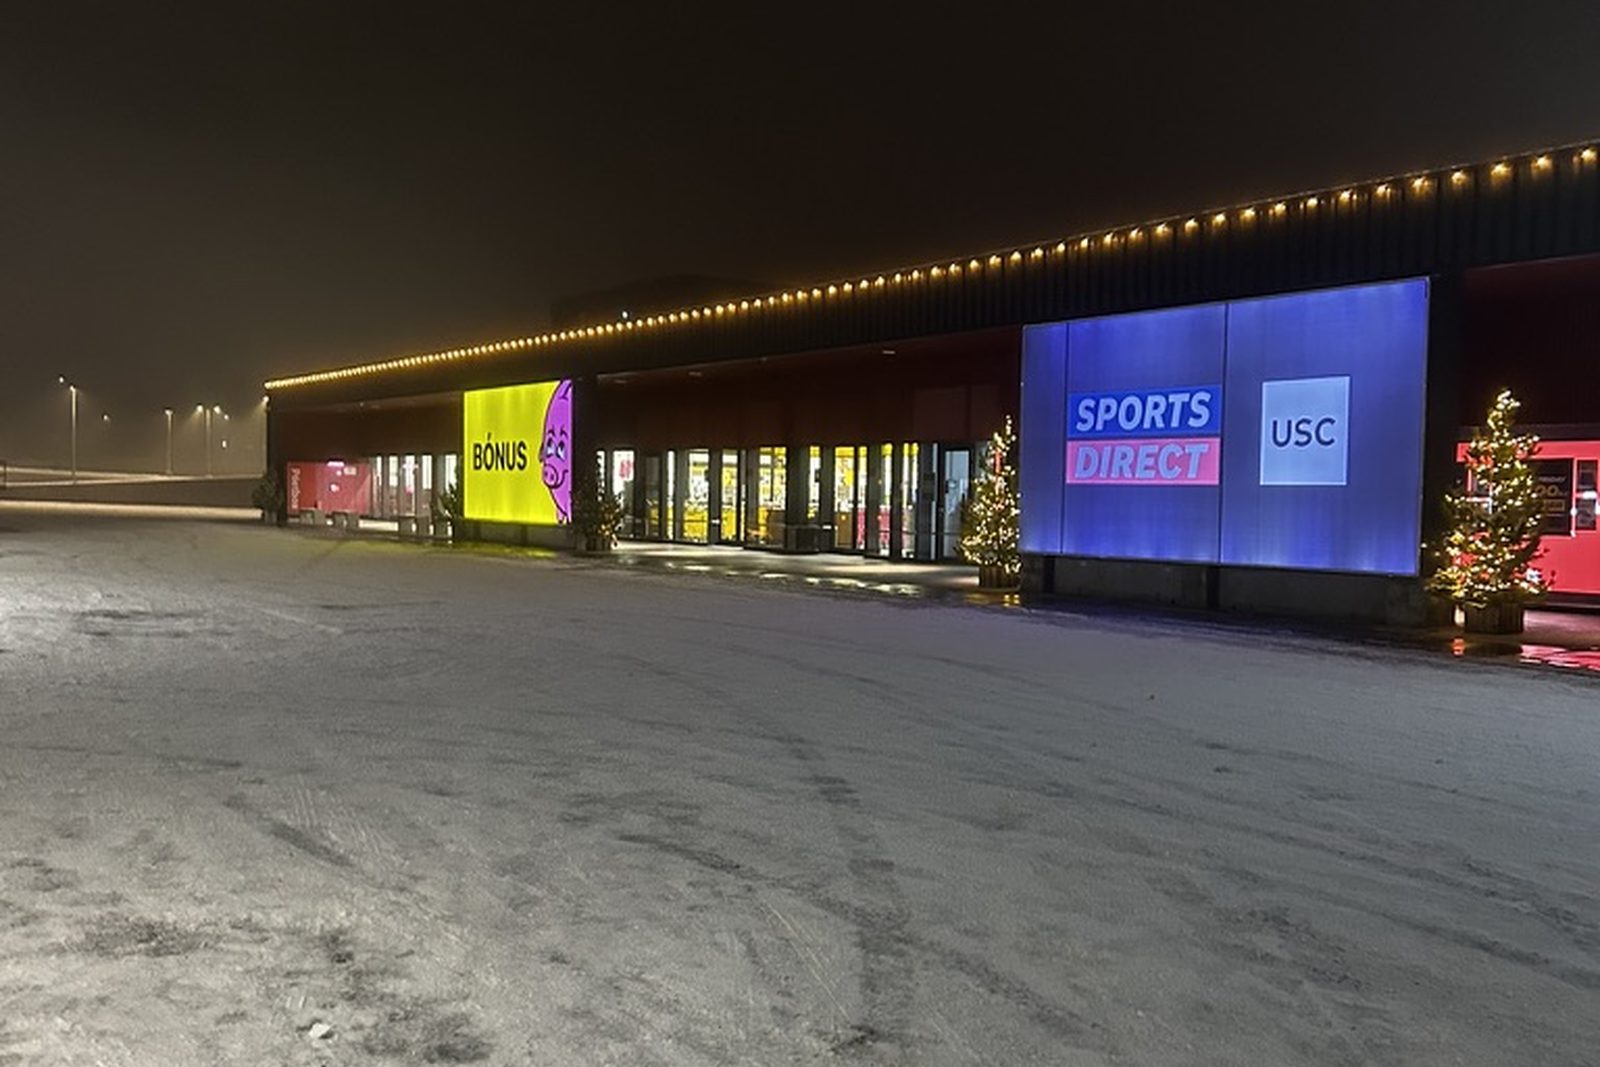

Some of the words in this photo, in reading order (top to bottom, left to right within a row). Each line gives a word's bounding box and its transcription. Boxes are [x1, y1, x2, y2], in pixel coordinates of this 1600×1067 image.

[1076, 392, 1211, 432] SPORTS
[473, 431, 527, 471] BÓNUS
[1272, 418, 1336, 447] USC
[1074, 444, 1209, 479] DIRECT
